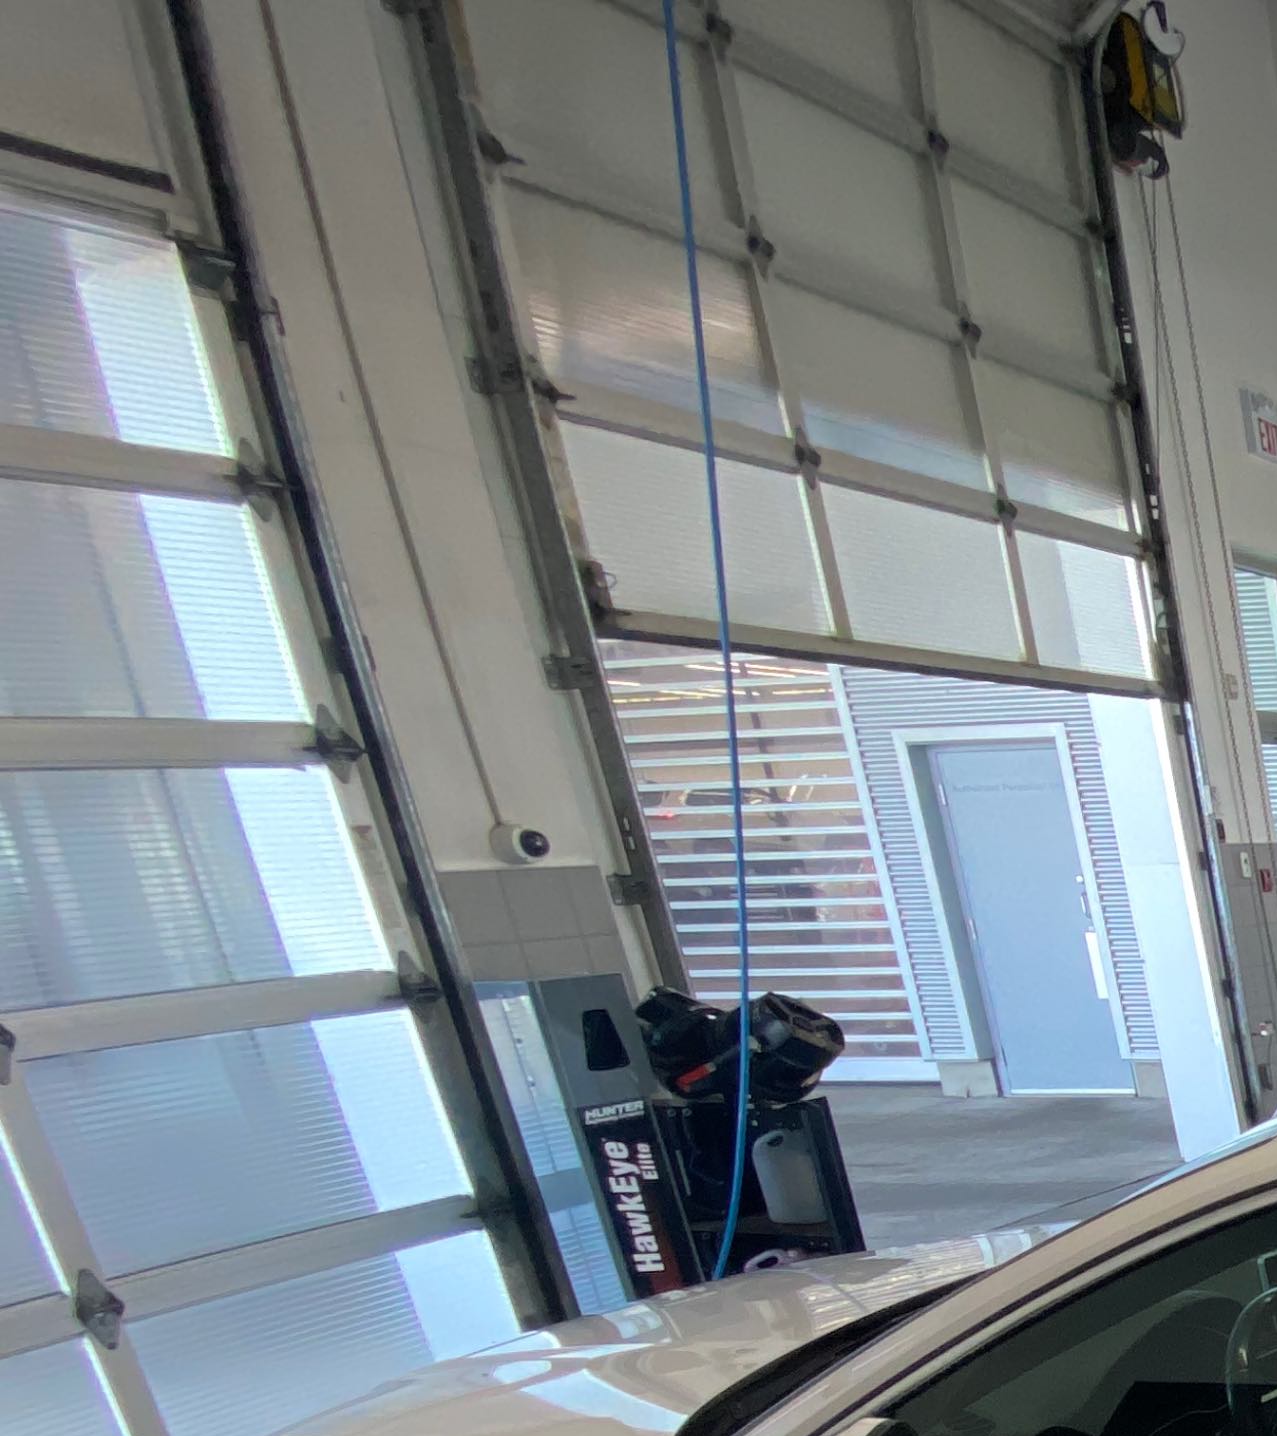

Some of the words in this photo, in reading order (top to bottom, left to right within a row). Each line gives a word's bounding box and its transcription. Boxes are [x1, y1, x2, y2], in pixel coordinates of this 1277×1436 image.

[585, 1100, 644, 1121] HUNTER
[637, 1142, 659, 1180] Elite
[604, 1140, 665, 1273] HawkEye
